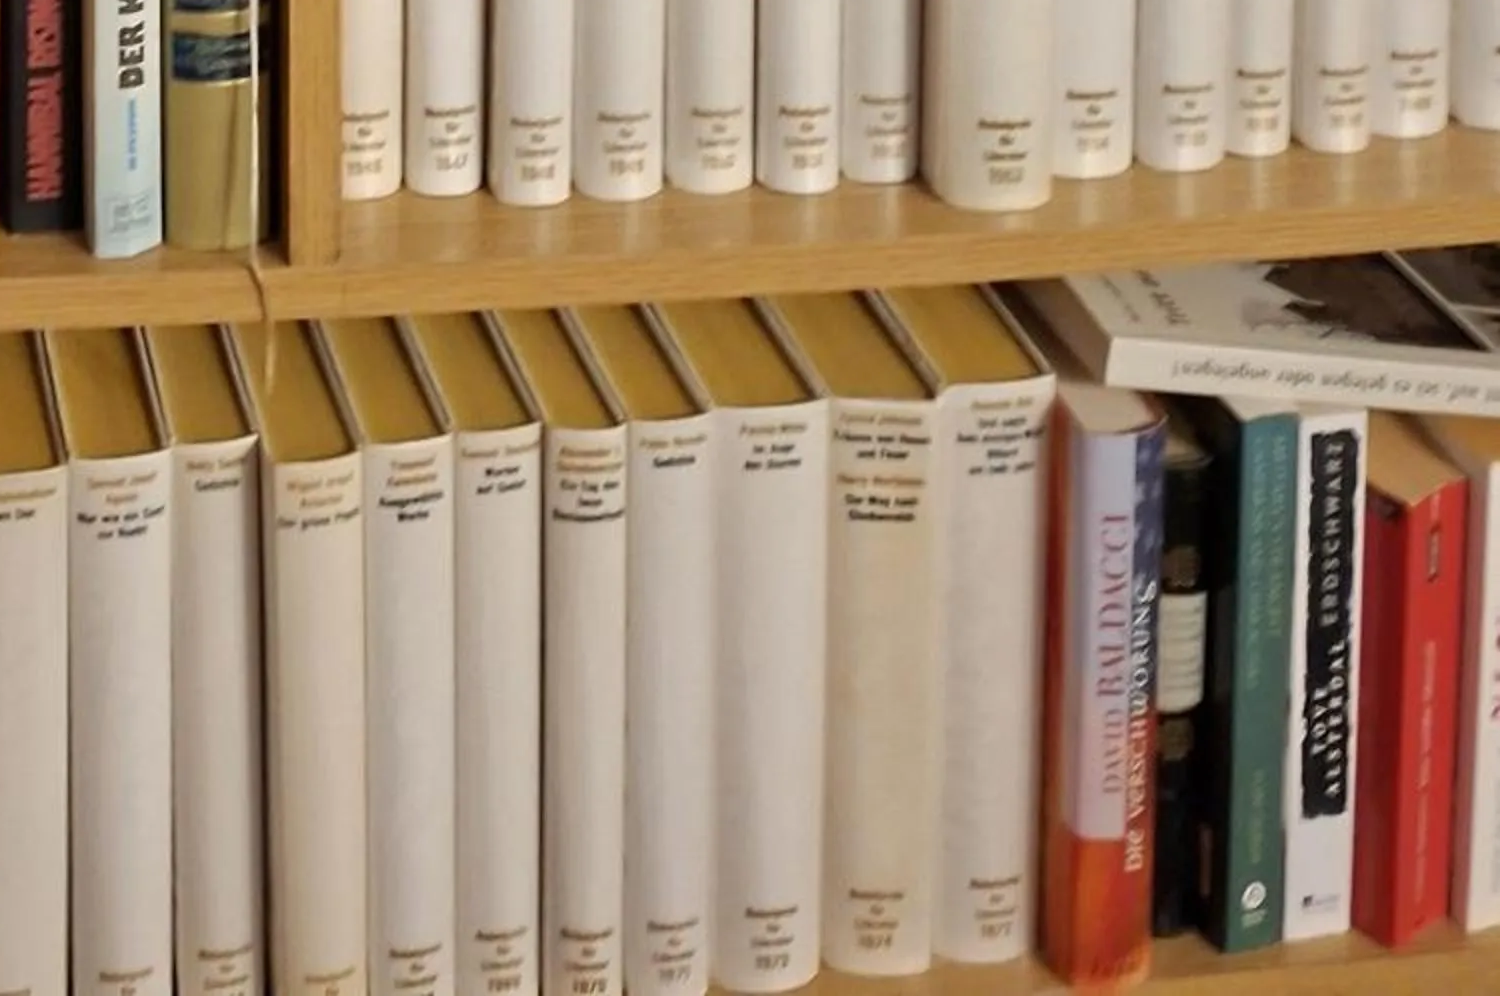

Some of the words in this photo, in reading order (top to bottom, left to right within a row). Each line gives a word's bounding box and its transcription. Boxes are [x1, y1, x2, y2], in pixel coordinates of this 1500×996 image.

[117, 20, 145, 90] DER
[25, 71, 65, 201] HANNIBAL
[1318, 441, 1346, 627] ERDSCHWARZ
[1096, 512, 1129, 698] BALDACCI
[1101, 708, 1124, 794] DAVID
[1309, 685, 1329, 755] TOVE
[1322, 637, 1346, 799] ALSTERDAL
